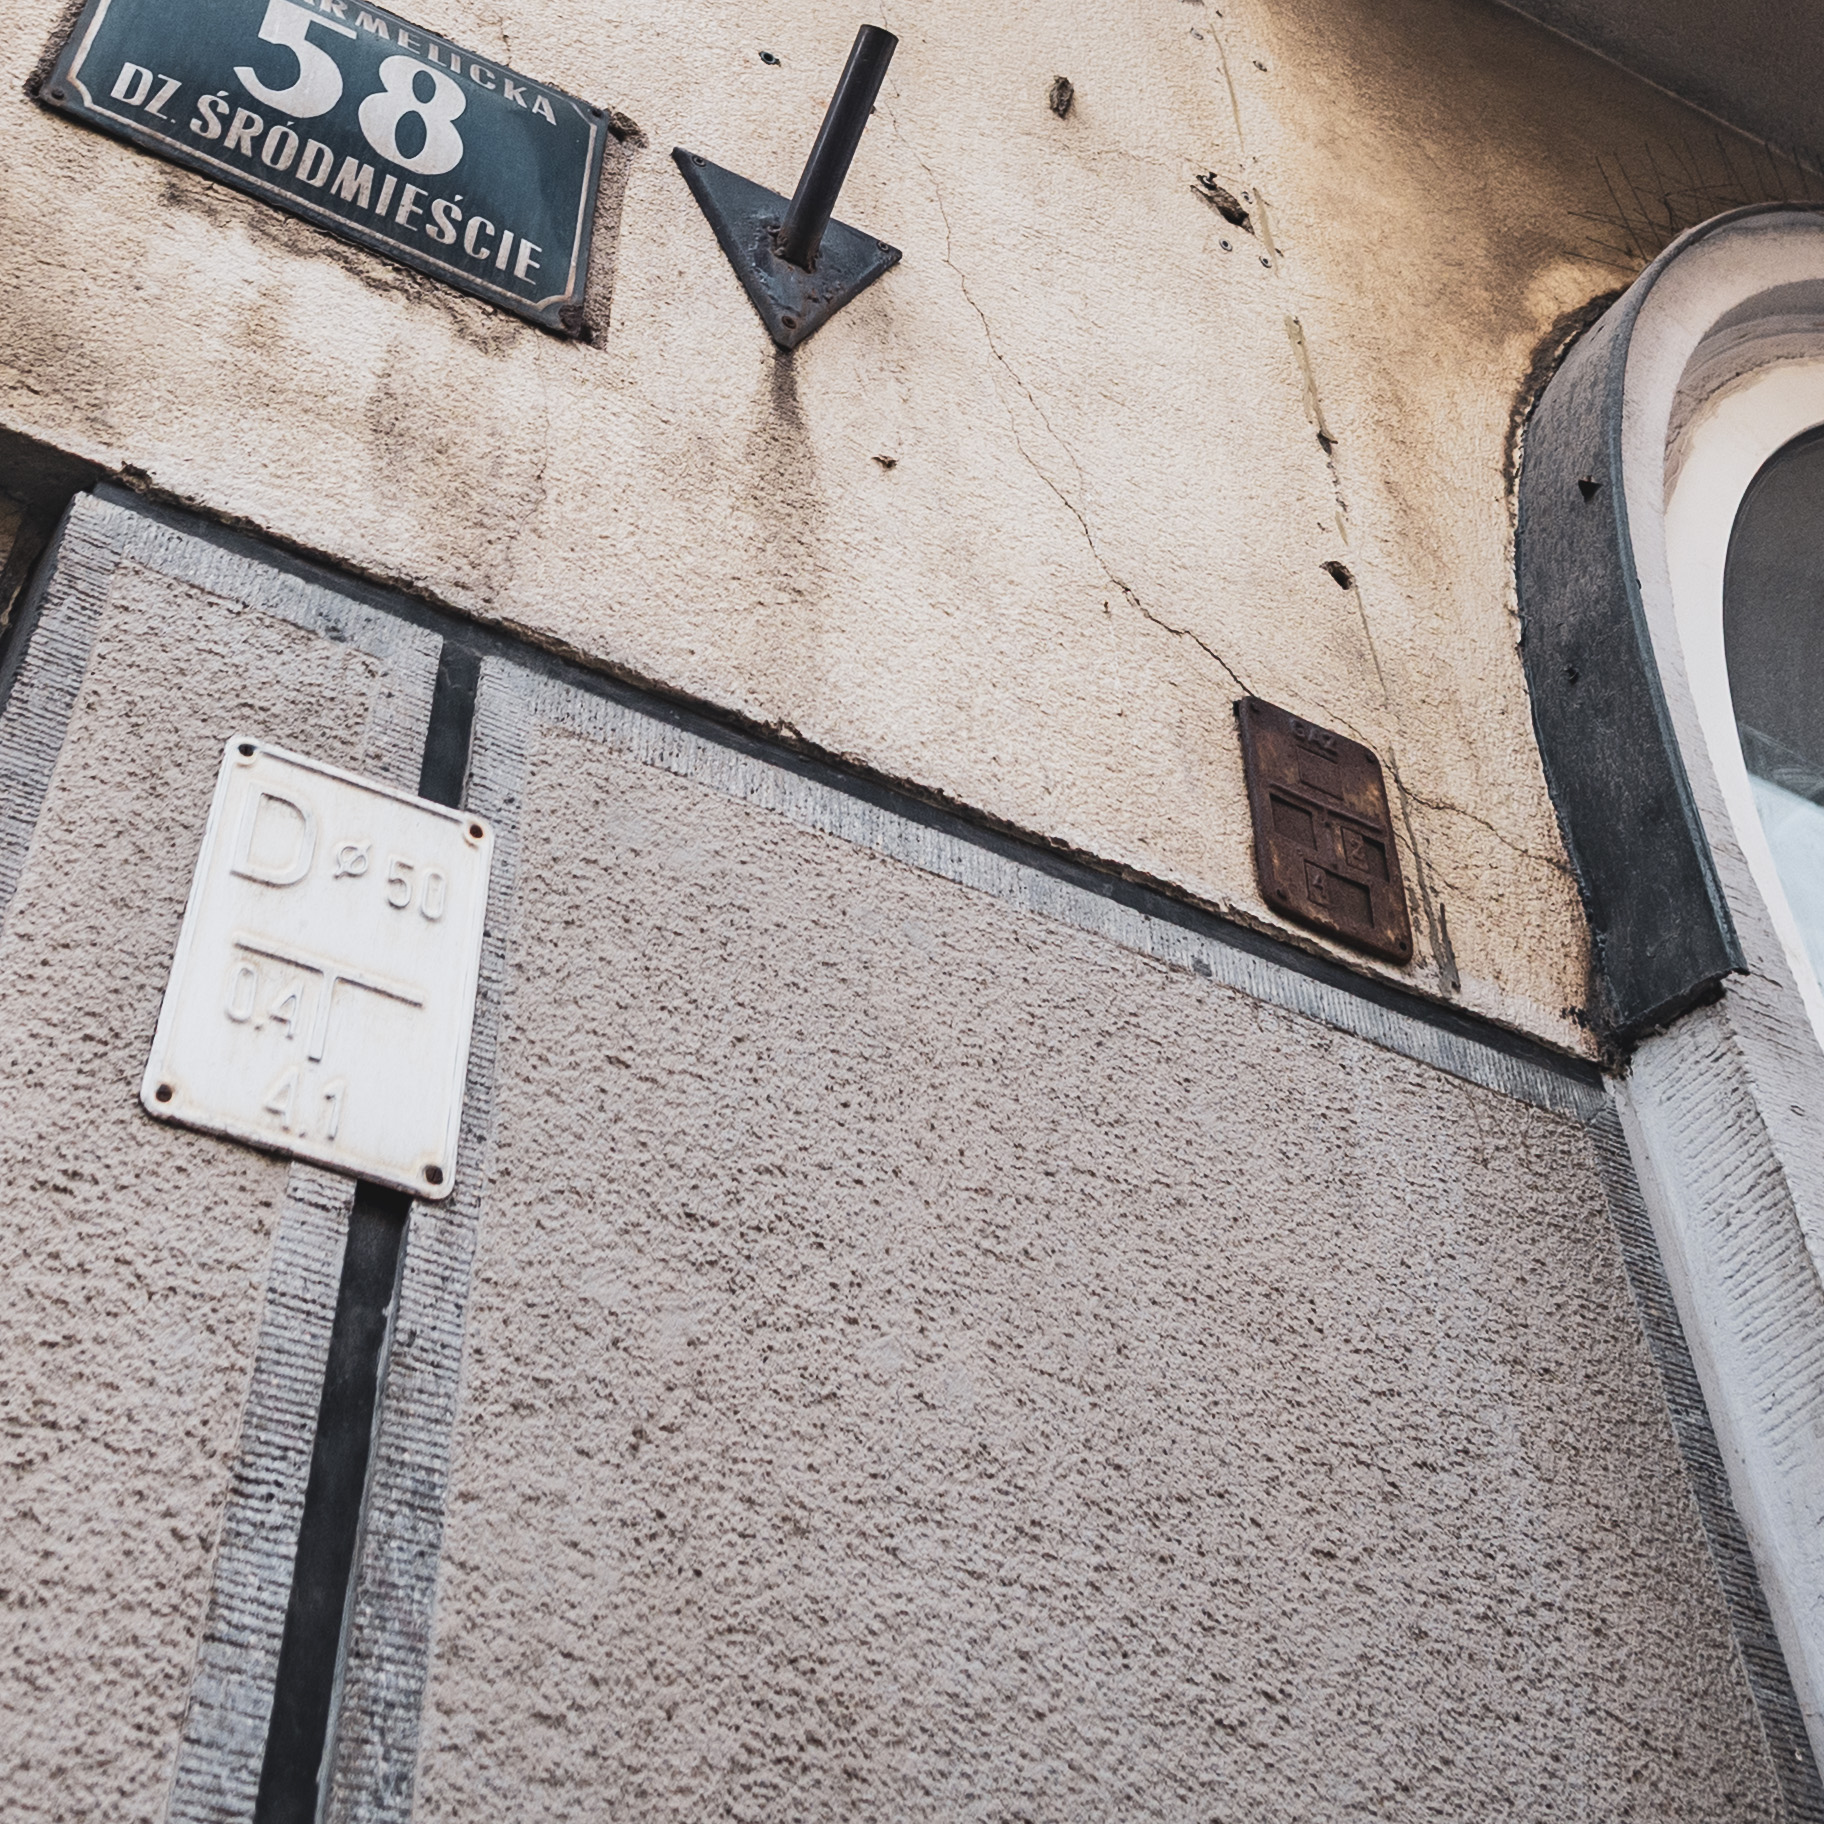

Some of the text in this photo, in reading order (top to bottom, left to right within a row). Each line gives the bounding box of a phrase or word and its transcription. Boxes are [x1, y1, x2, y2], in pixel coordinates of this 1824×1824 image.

[109, 60, 543, 286] DZ. ŚRÓDMIEŚCIE
[230, 780, 318, 888] D
[386, 855, 447, 923] 50
[224, 960, 306, 1040] 0.4
[264, 1065, 349, 1142] 4.1
